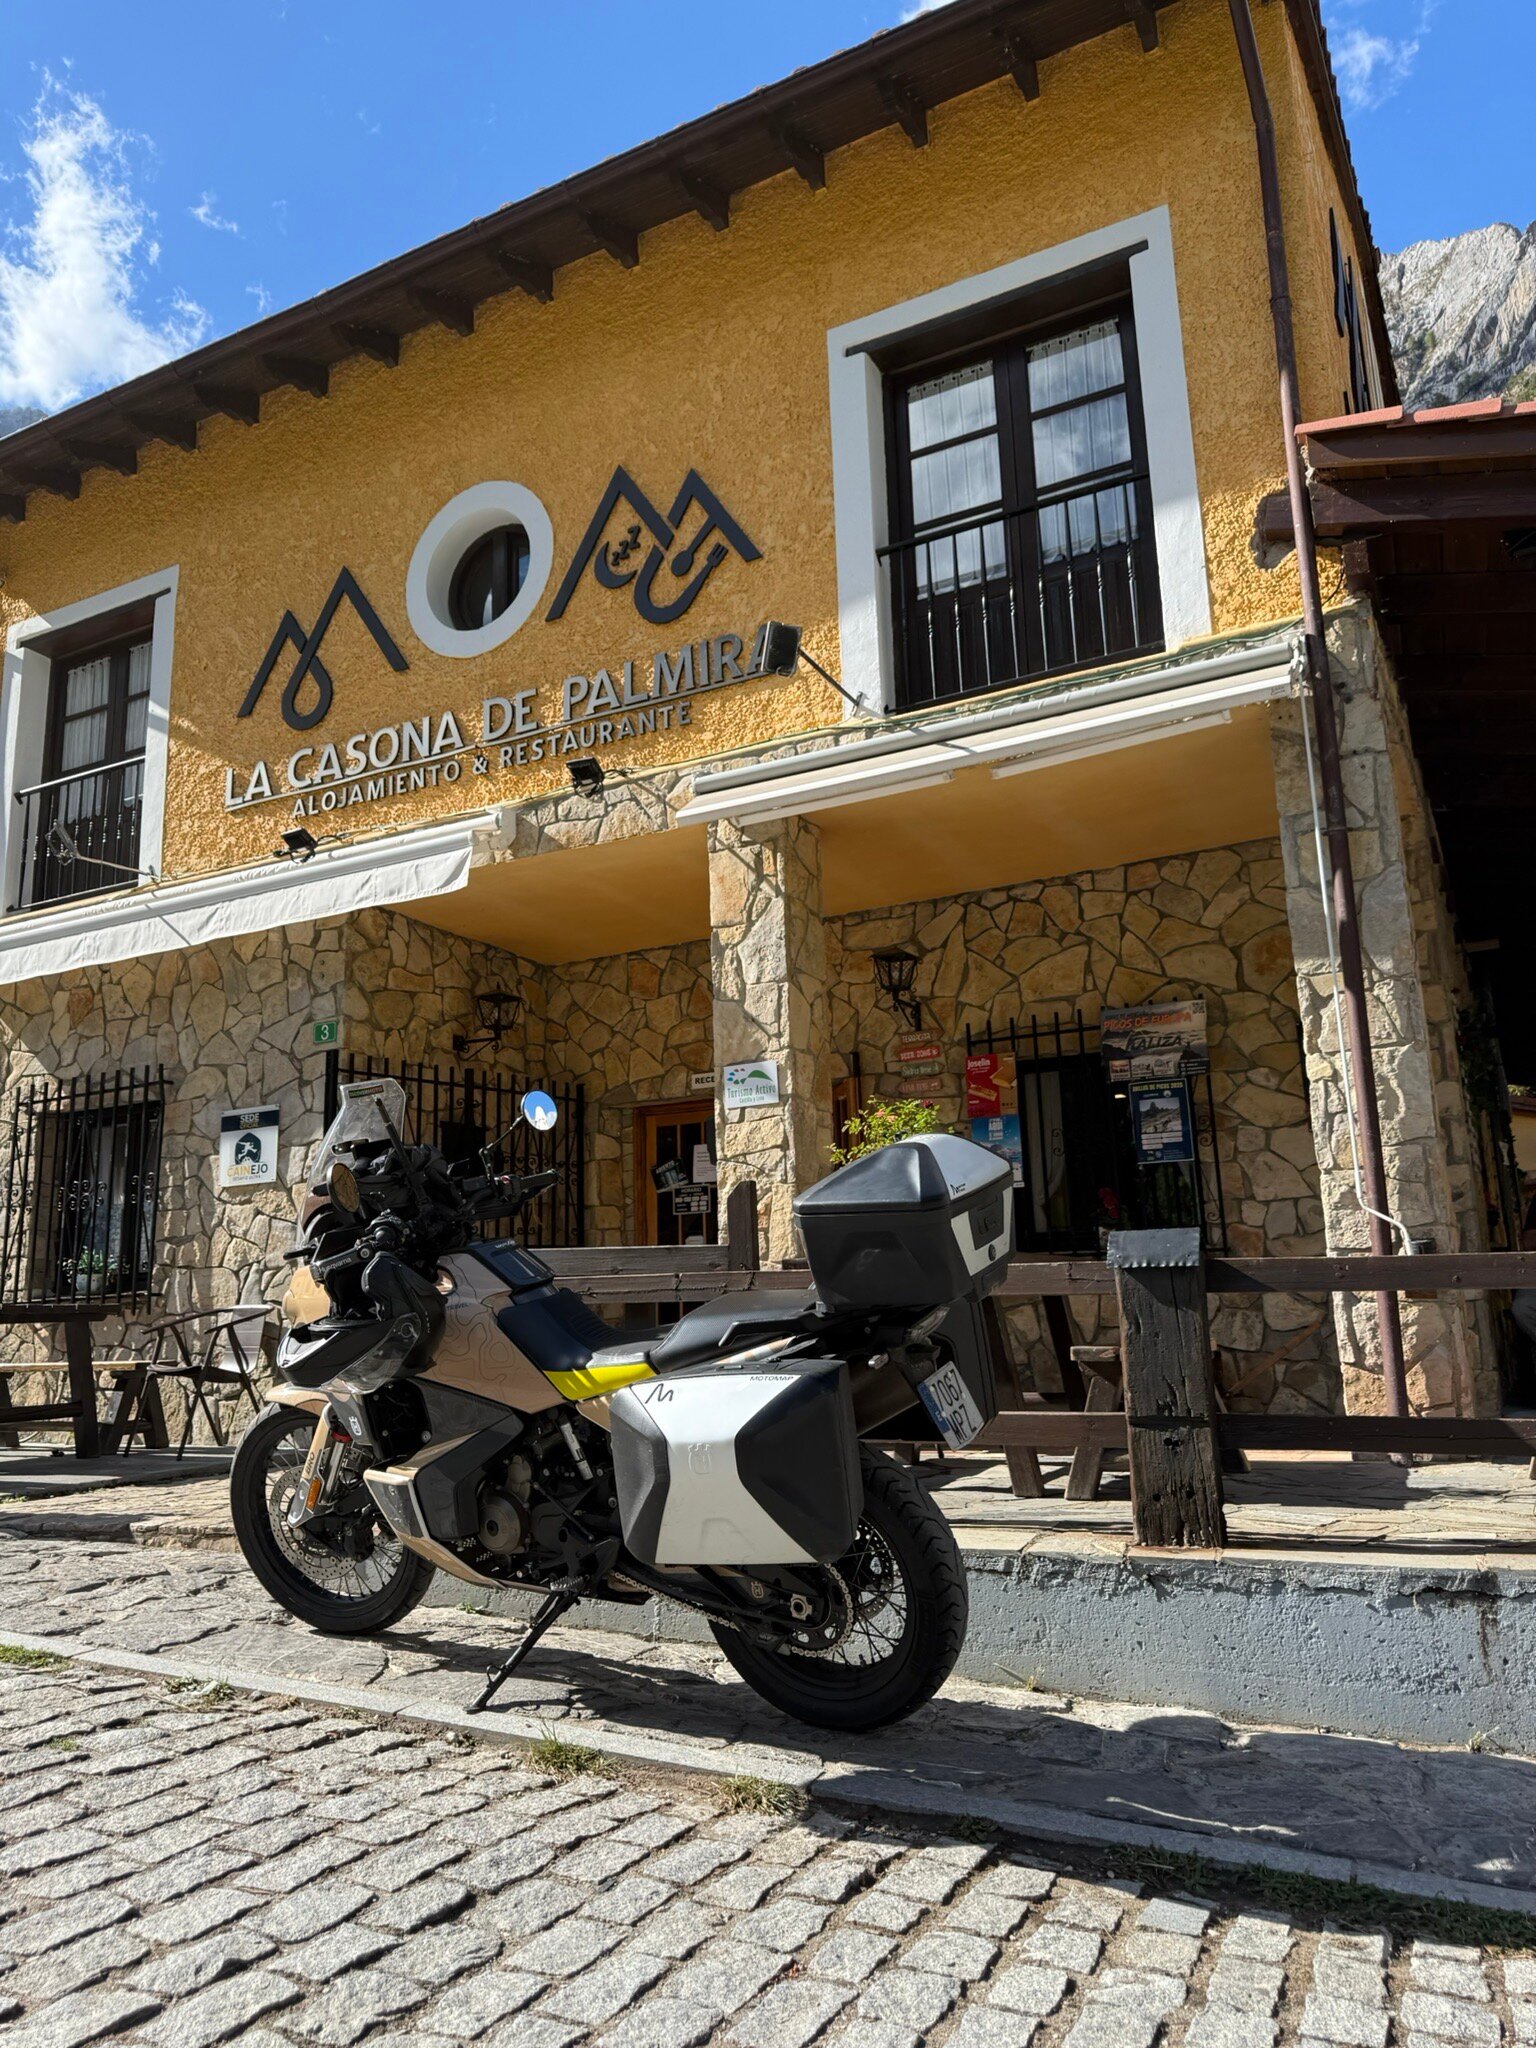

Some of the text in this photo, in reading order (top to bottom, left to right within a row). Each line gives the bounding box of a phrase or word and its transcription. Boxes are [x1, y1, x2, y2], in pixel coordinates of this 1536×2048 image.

[225, 761, 272, 806] LA
[287, 711, 465, 788] CASONA
[482, 688, 539, 741] DE
[292, 702, 692, 818] ALOJAMIENTO & RESTAURANTE
[1103, 1019, 1133, 1030] PICOS
[1135, 1016, 1149, 1026] DE
[320, 1024, 329, 1040] 3
[727, 1085, 776, 1099] Turismo Activo
[239, 1112, 260, 1123] SEDE
[227, 1163, 269, 1177] CAINEJO
[931, 1368, 962, 1411] 7067
[946, 1404, 977, 1445] MPZ
